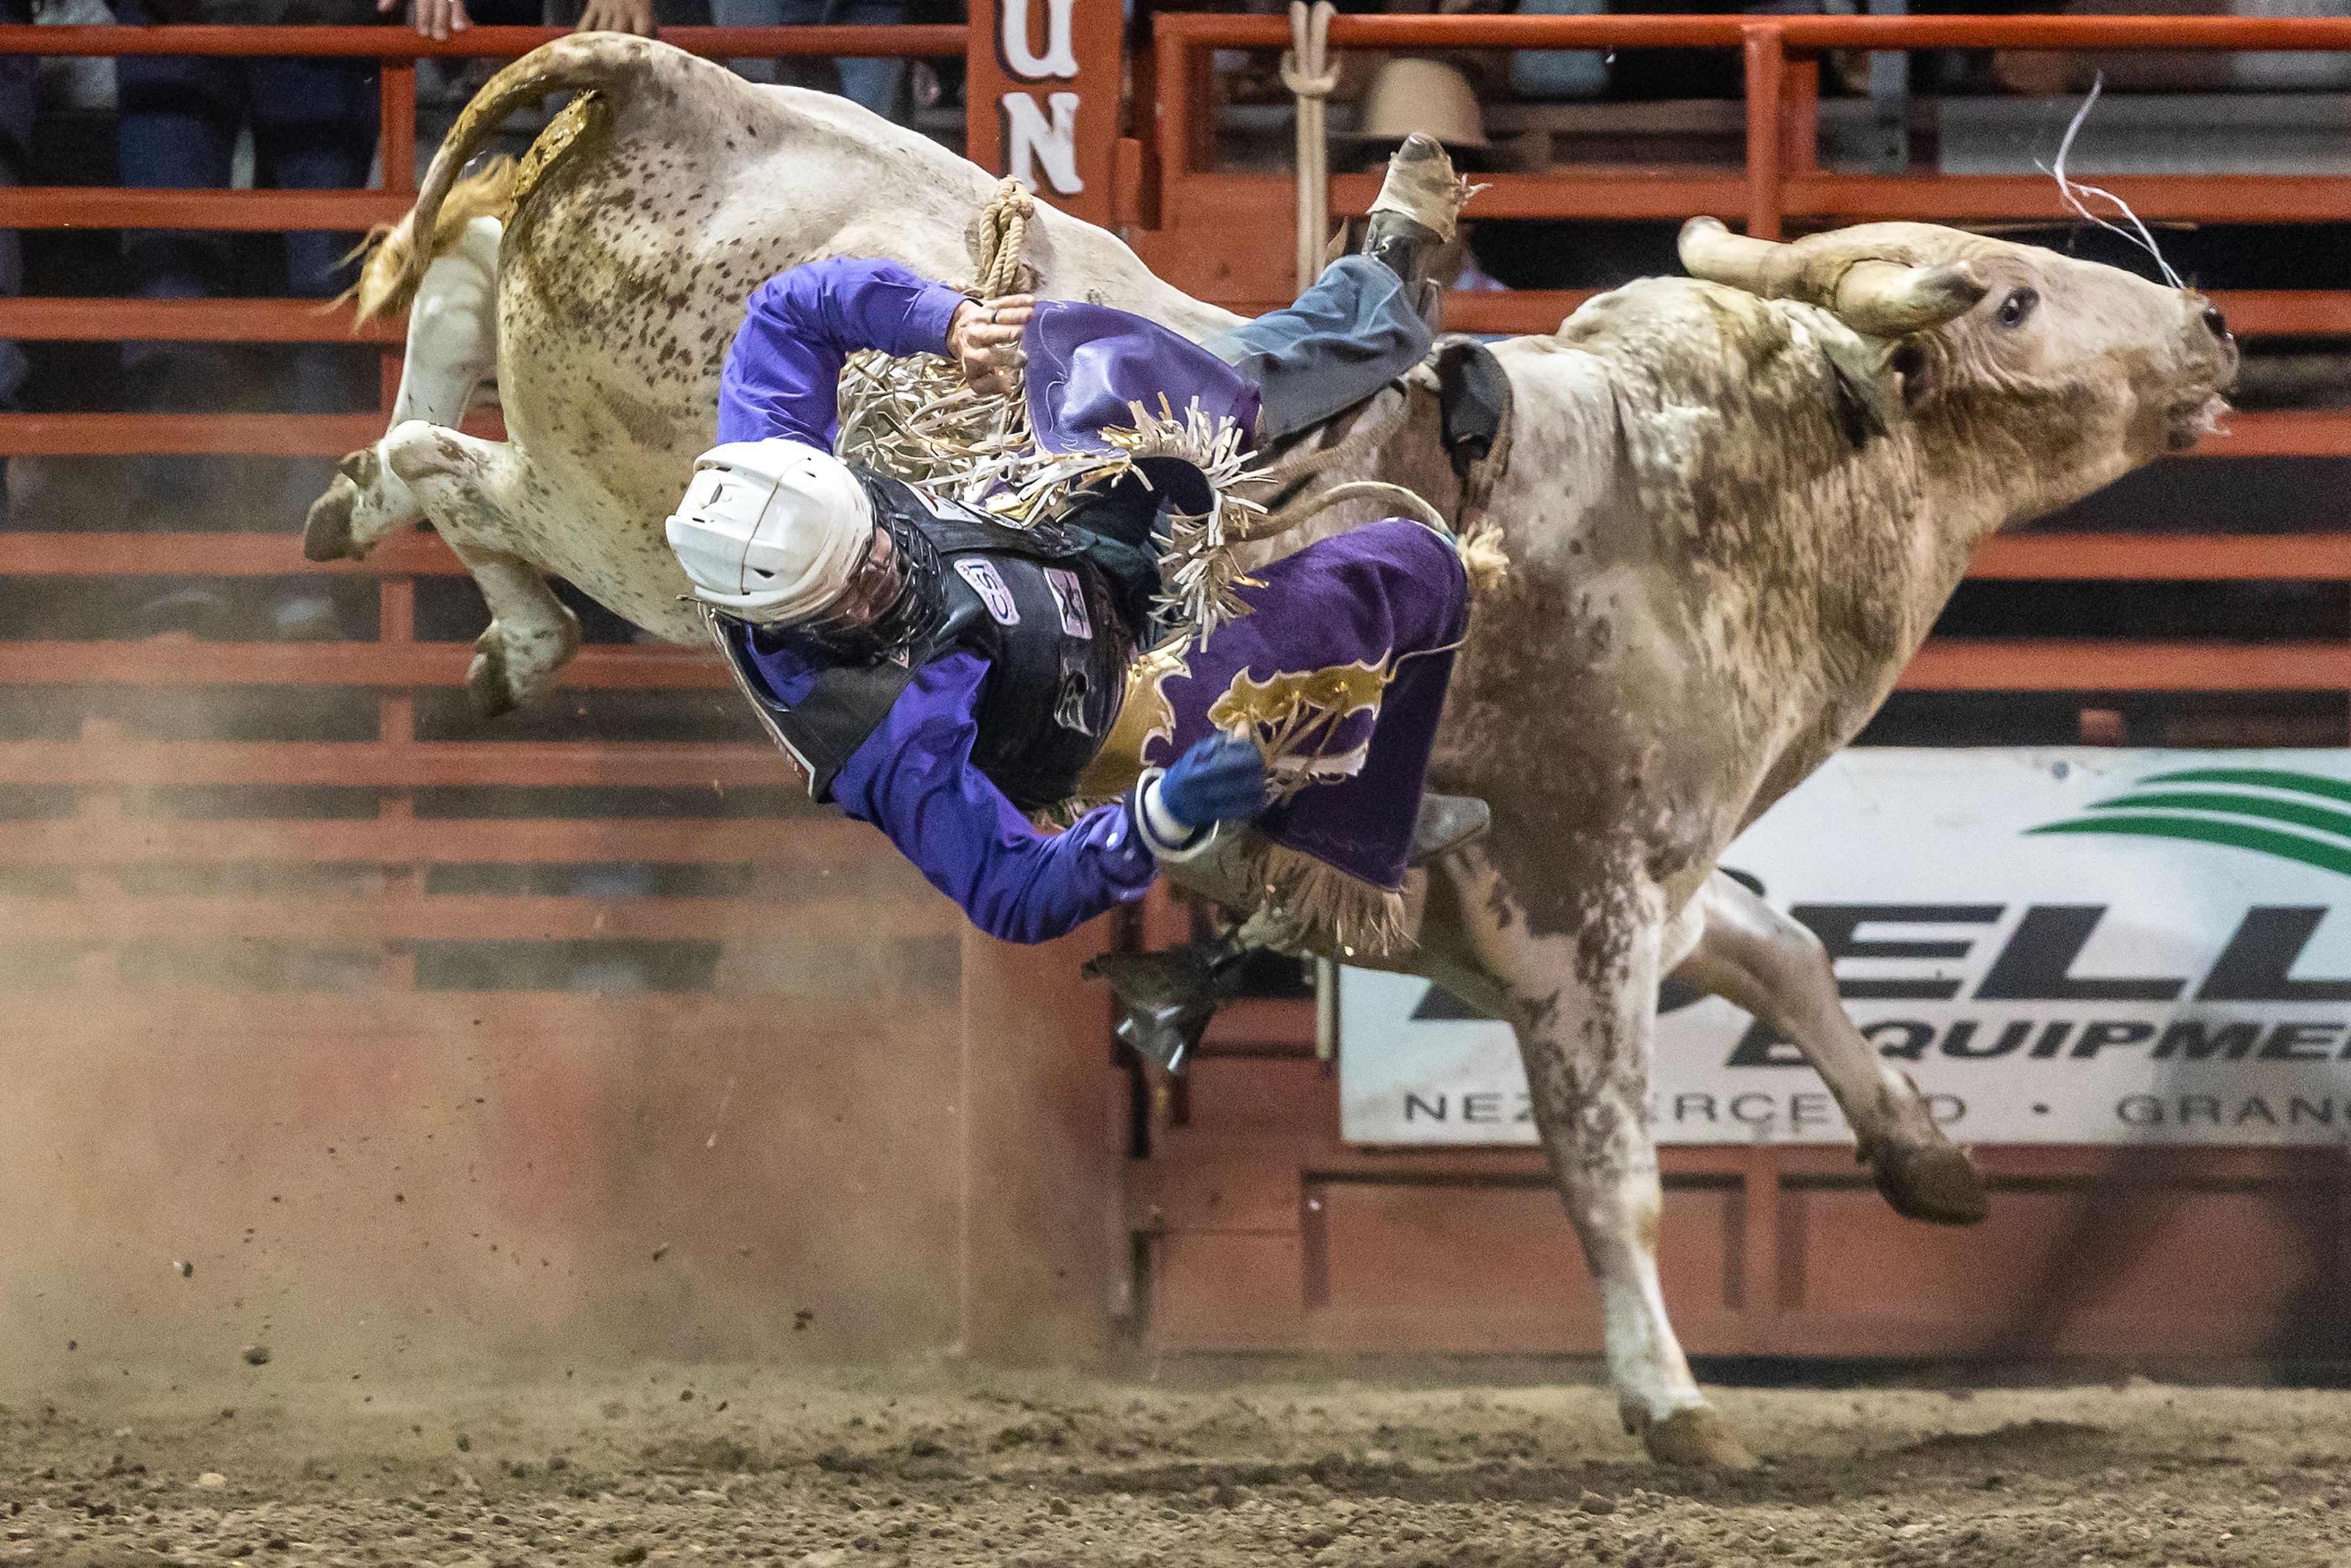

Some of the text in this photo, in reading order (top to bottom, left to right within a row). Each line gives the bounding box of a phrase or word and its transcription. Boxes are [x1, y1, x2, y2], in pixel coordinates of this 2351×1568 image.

[967, 565, 1009, 619] CSI
[1724, 1014, 2351, 1068] EQUIPME
[2117, 1093, 2351, 1125] GRAN
